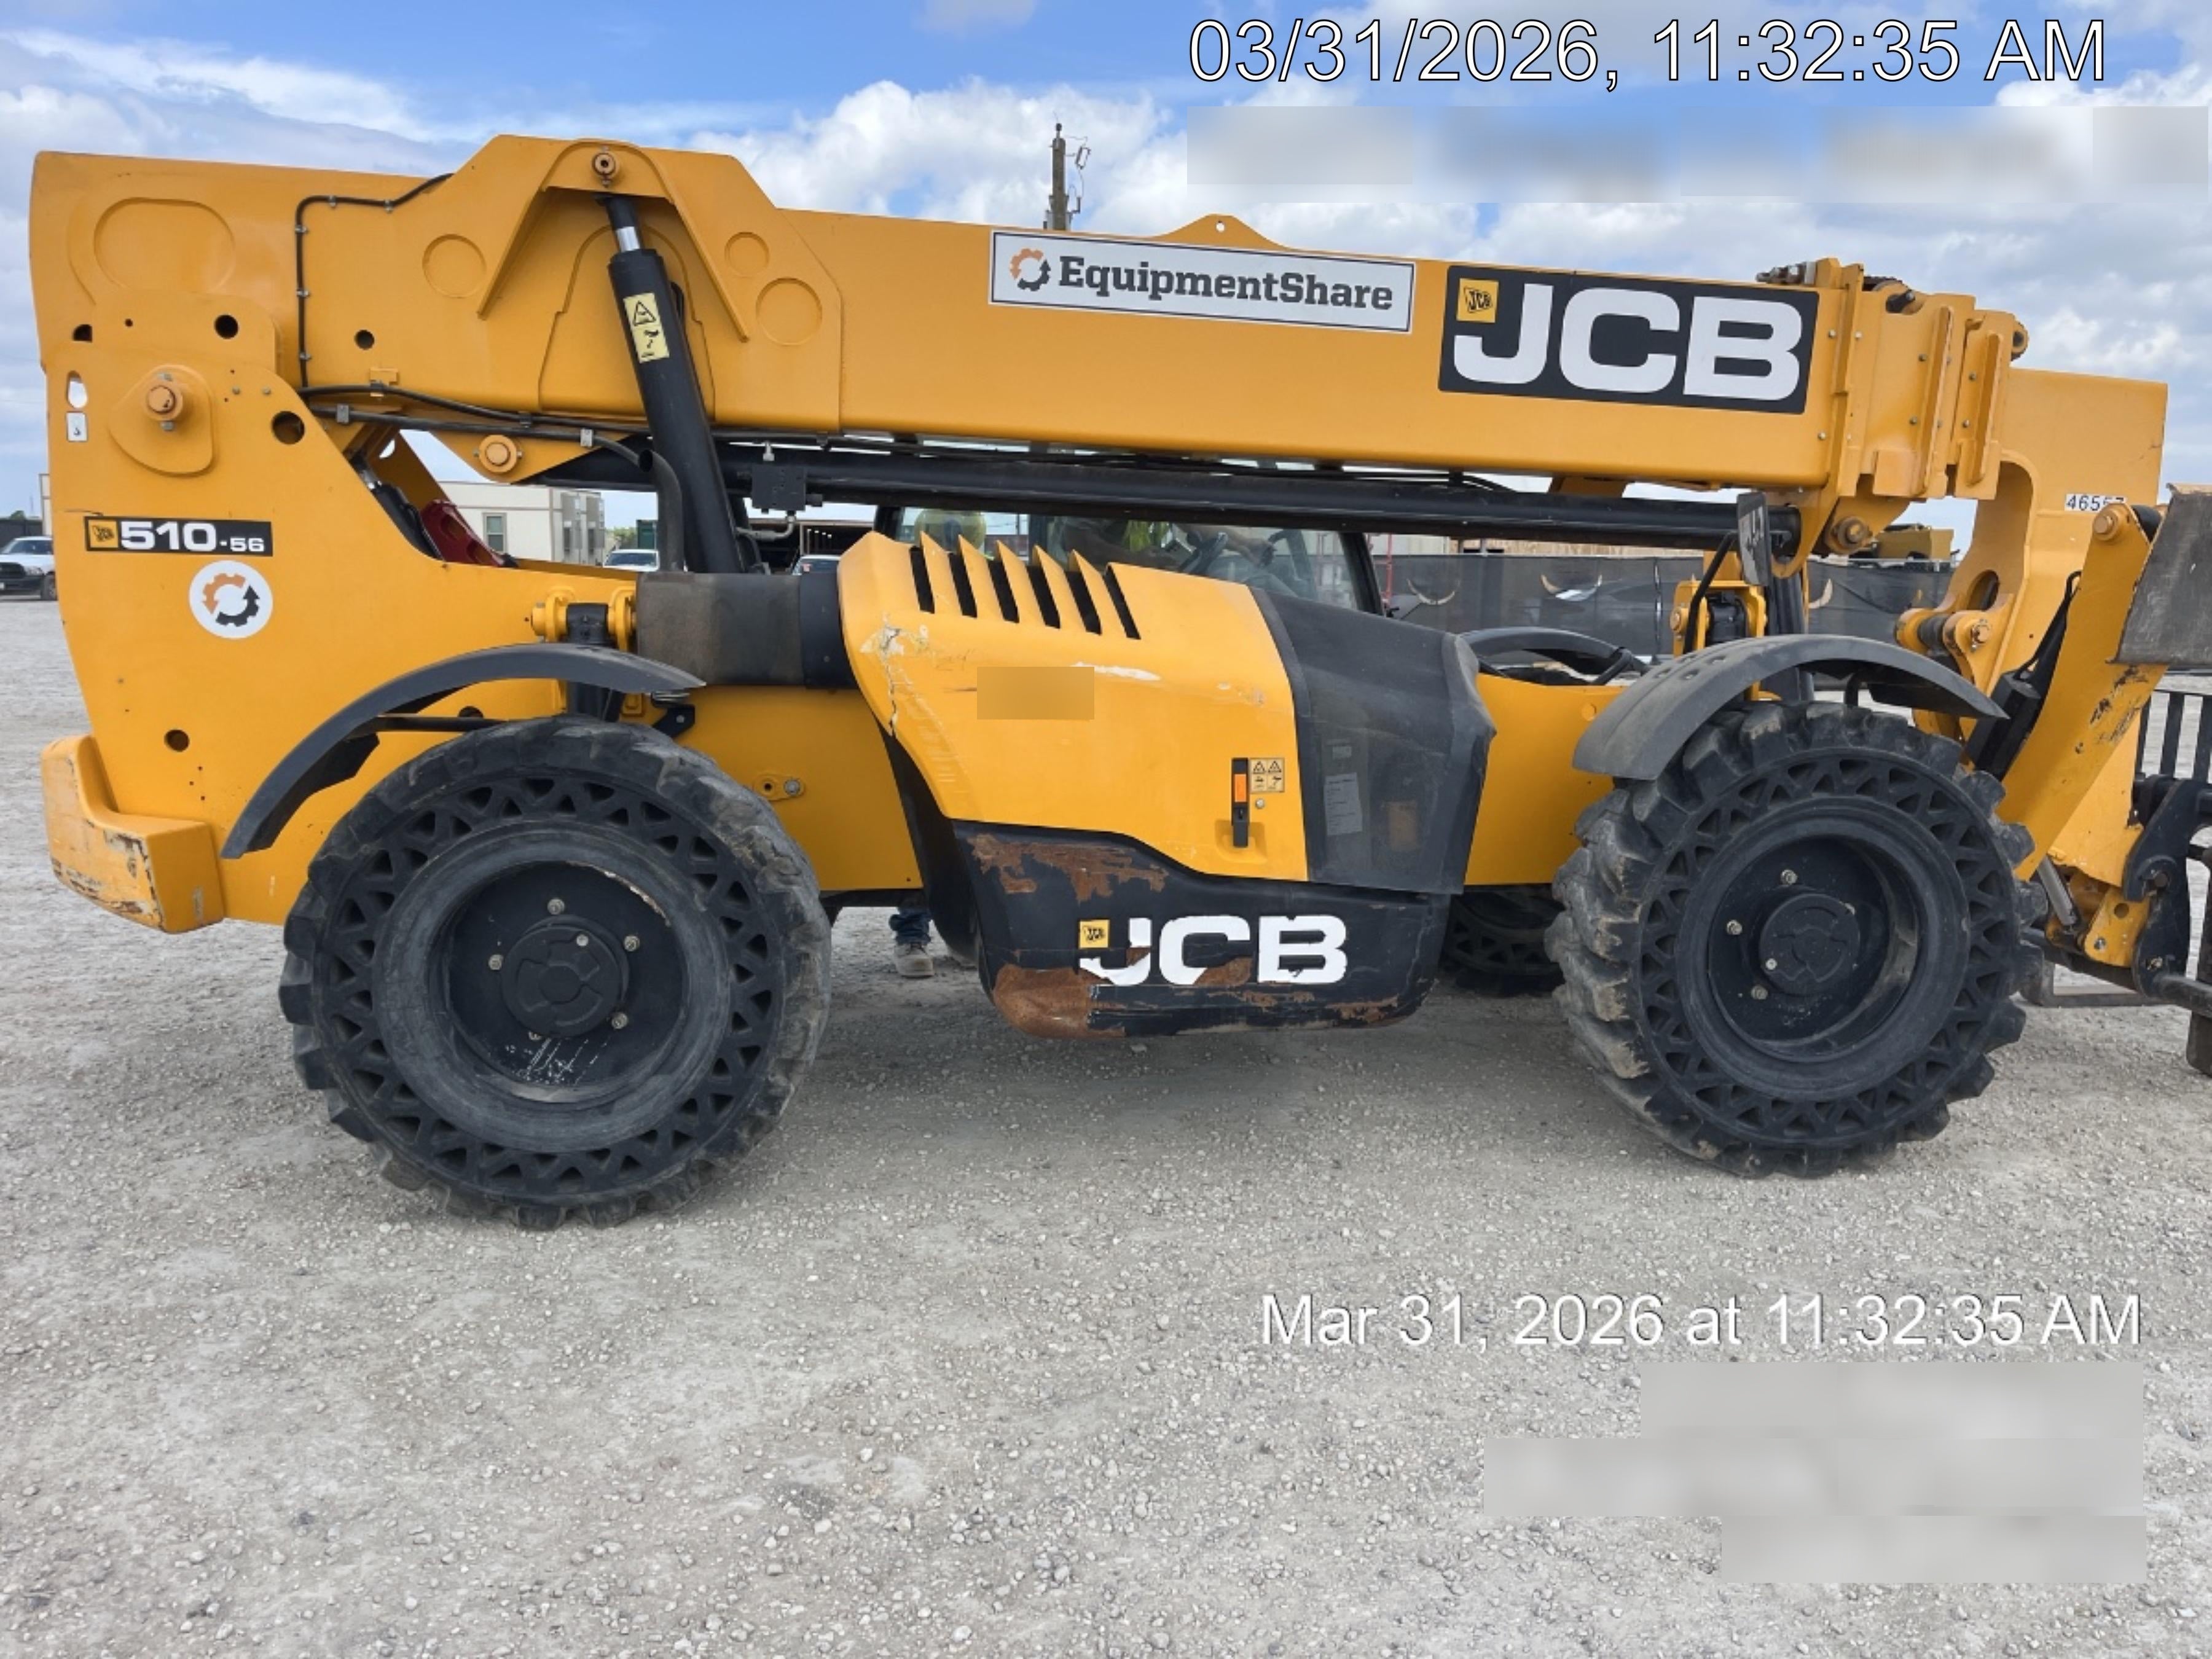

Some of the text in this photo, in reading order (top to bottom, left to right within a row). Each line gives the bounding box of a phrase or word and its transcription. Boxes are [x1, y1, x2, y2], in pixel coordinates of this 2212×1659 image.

[1059, 254, 1392, 310] EquipmentShare
[1454, 283, 1803, 401] JCB
[2066, 494, 2124, 511] 465
[120, 520, 265, 552] 510-56
[1079, 915, 1348, 986] JCB
